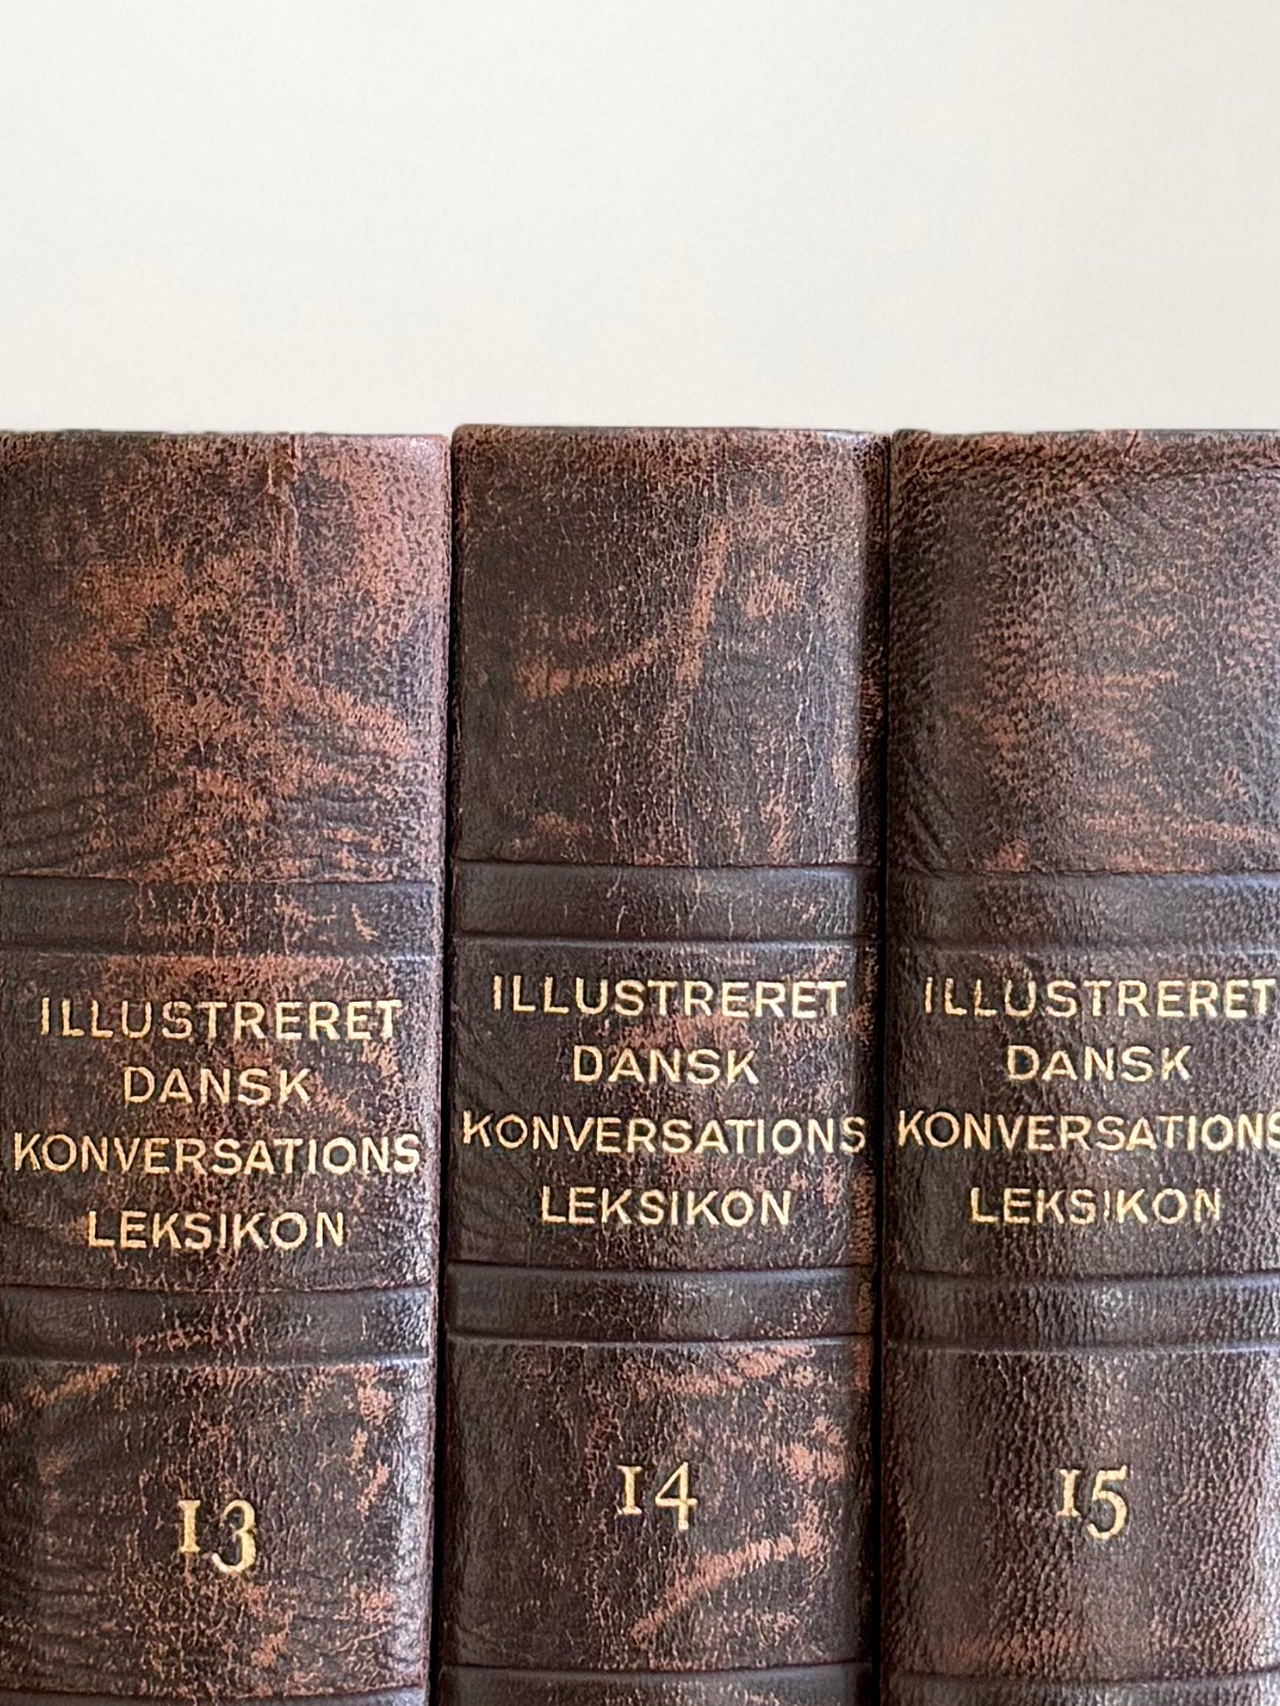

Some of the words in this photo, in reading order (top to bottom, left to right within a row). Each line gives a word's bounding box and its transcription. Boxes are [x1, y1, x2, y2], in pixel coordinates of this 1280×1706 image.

[493, 974, 847, 1020] ILLUSTRERET
[924, 976, 1274, 1019] ILLUSTRERET
[40, 997, 403, 1042] ILLUSTRERET
[571, 1043, 760, 1085] DANSK
[1004, 1043, 1193, 1083] DANSK
[122, 1066, 312, 1107] DANSK
[461, 1109, 866, 1155] KONVERSATIONS
[13, 1132, 421, 1176] KONVERSATIONS
[540, 1186, 792, 1226] LEKSIKON
[968, 1186, 1223, 1225] LEKSIKON
[86, 1210, 346, 1250] LEKSIKON
[617, 1463, 698, 1531] 14
[1057, 1468, 1131, 1540] 15
[180, 1500, 258, 1576] 13
